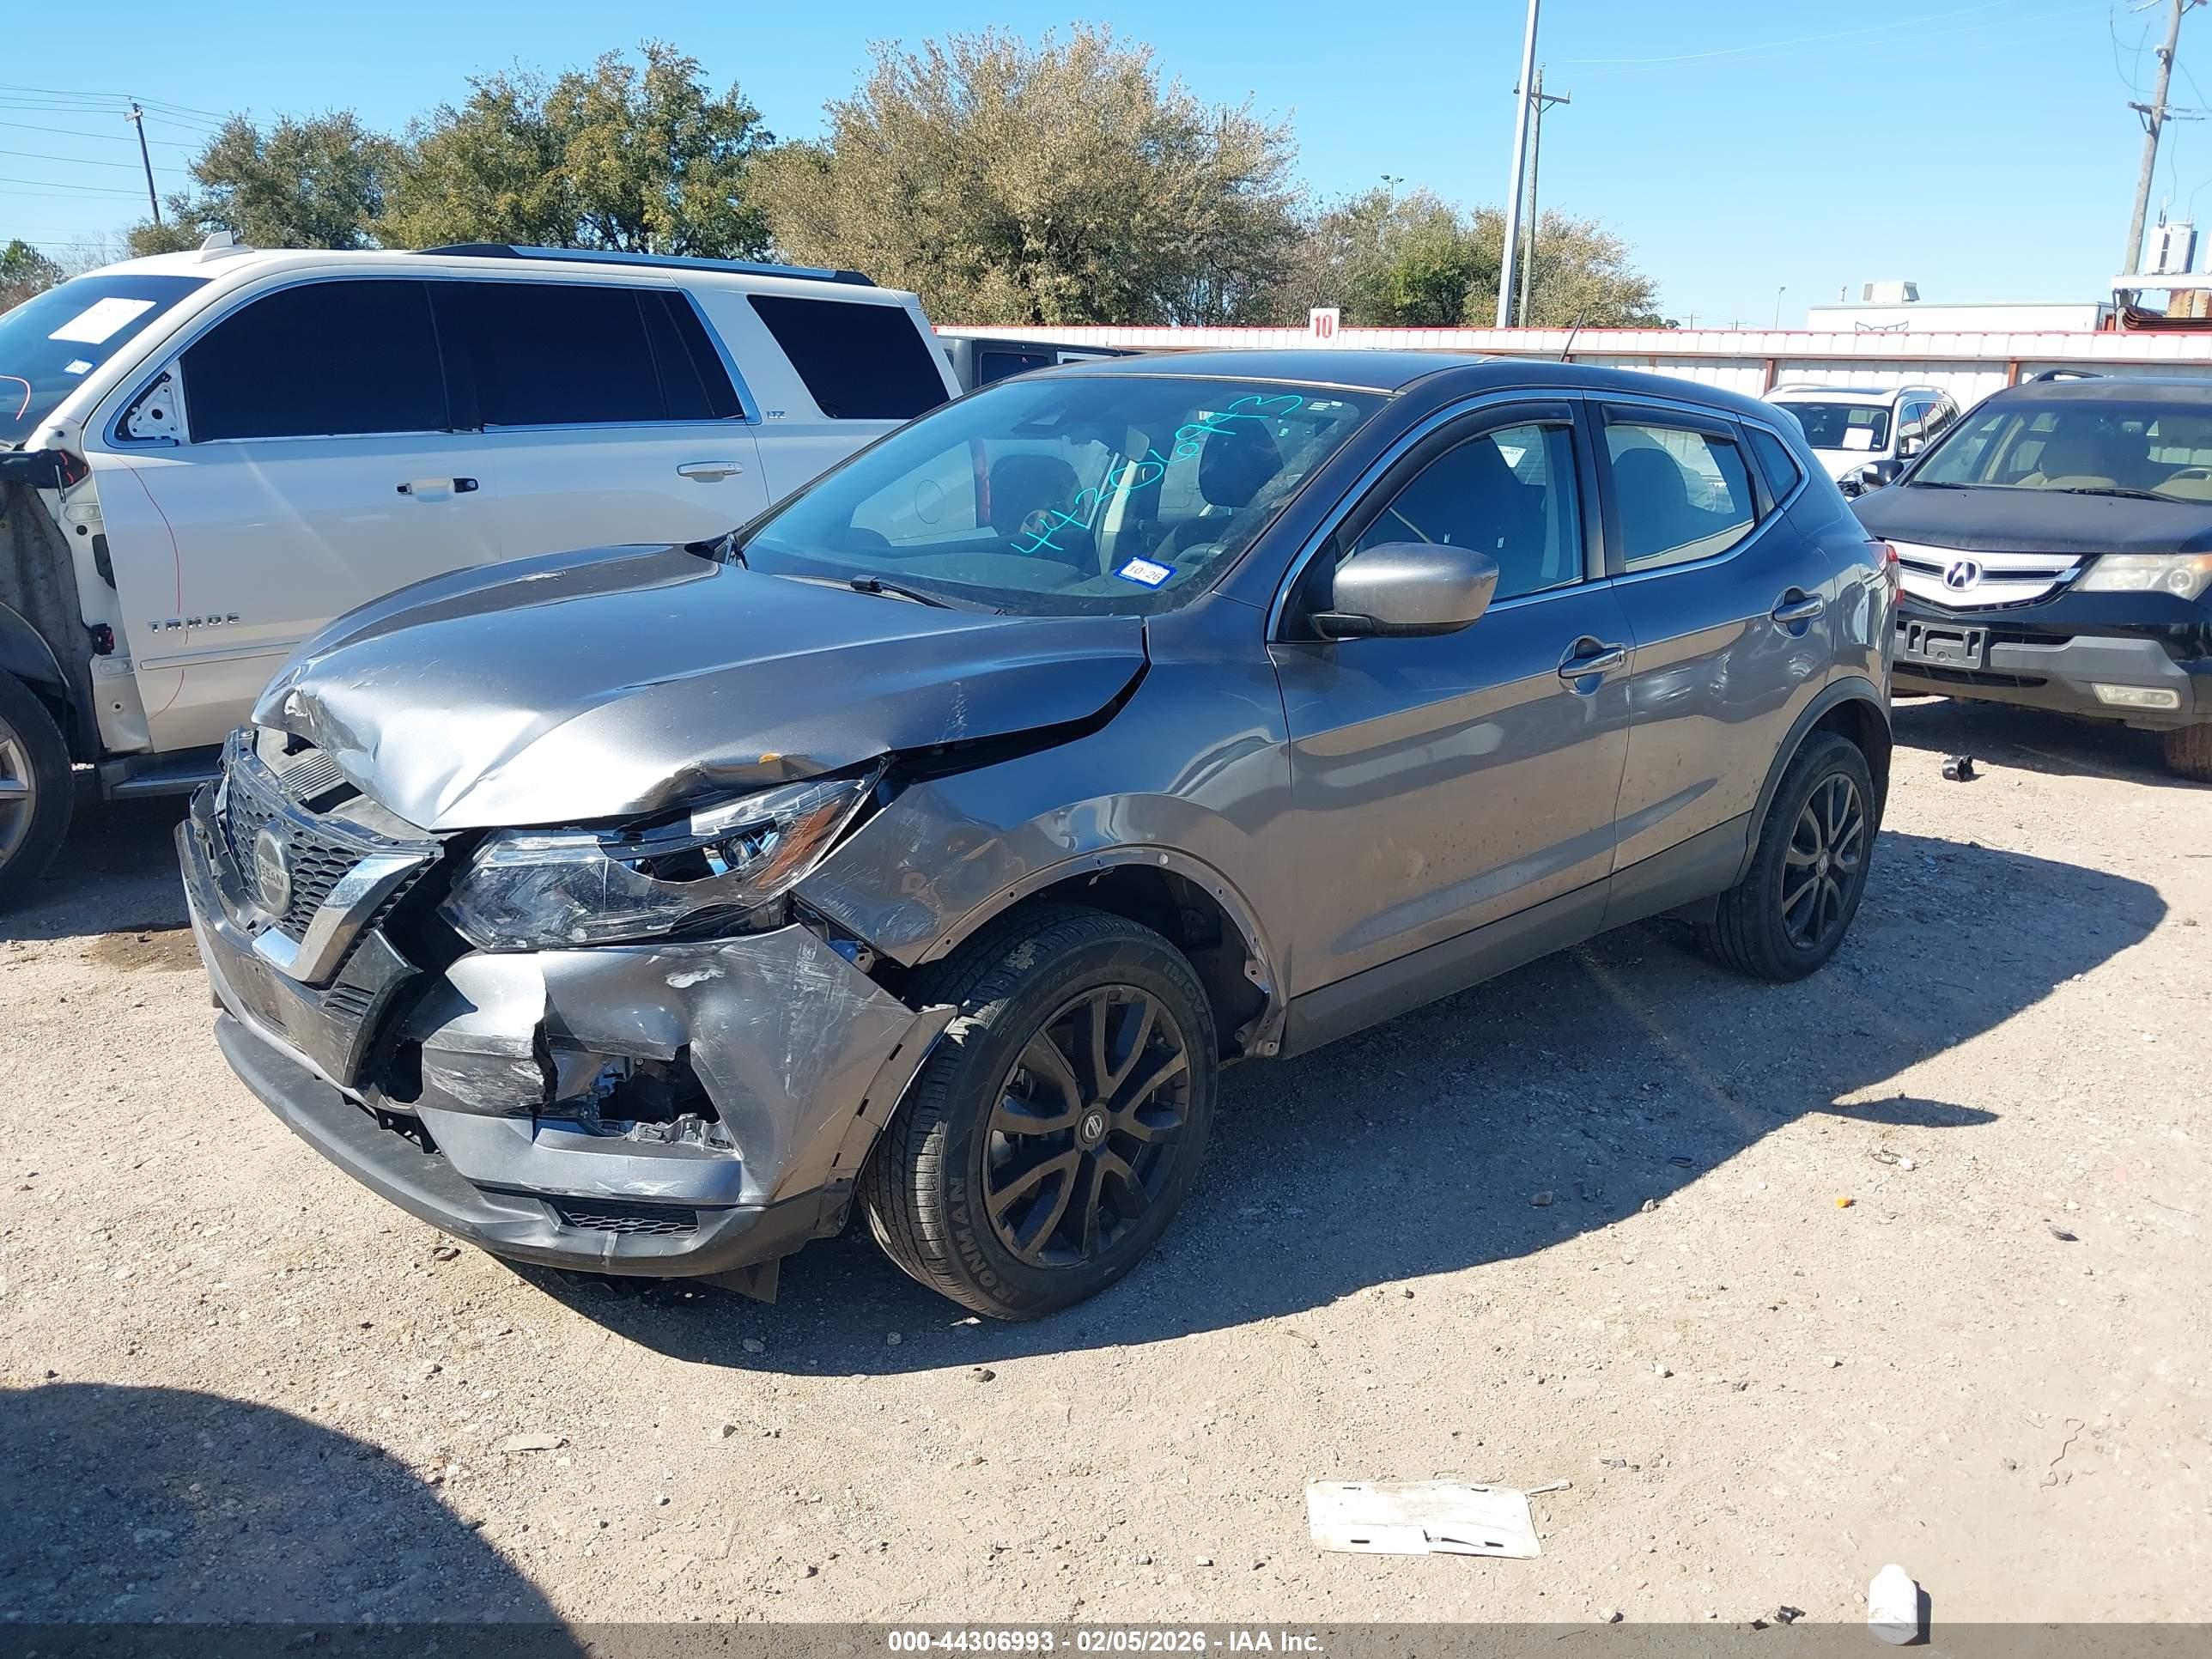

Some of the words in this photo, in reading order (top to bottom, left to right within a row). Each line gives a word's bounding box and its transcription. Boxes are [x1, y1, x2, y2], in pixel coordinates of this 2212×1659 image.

[1315, 314, 1333, 338] 10
[148, 613, 240, 632] TAHOE
[949, 1176, 1020, 1304] IRONMAN
